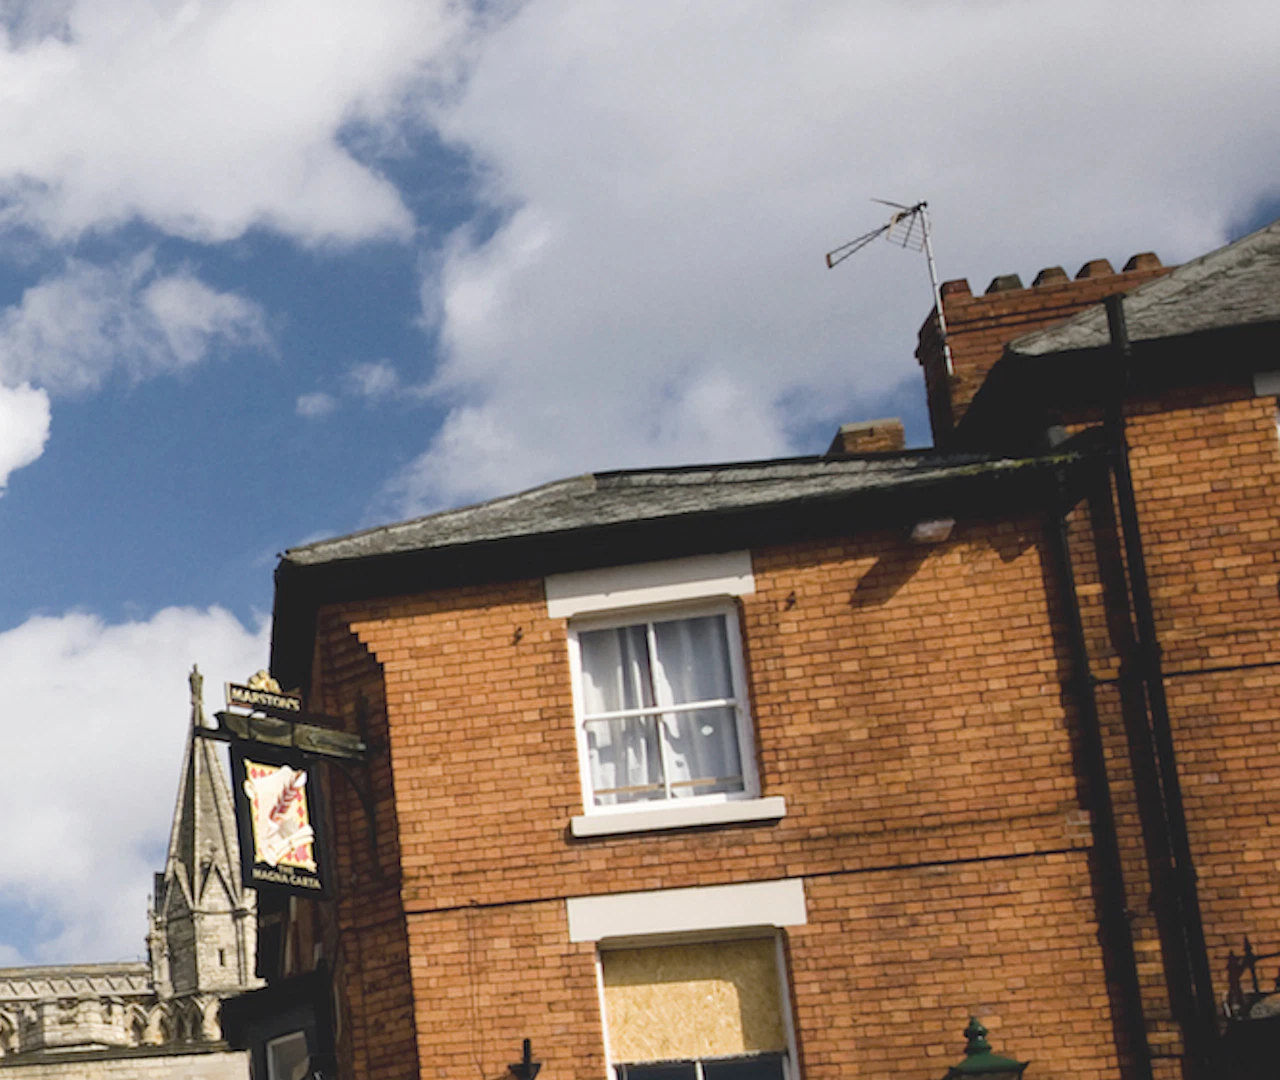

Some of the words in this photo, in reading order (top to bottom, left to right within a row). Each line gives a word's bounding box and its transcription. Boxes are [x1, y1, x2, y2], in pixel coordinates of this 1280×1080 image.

[231, 687, 300, 711] MARSTON'S
[252, 868, 289, 884] MAGNA
[289, 875, 322, 889] CARTA
